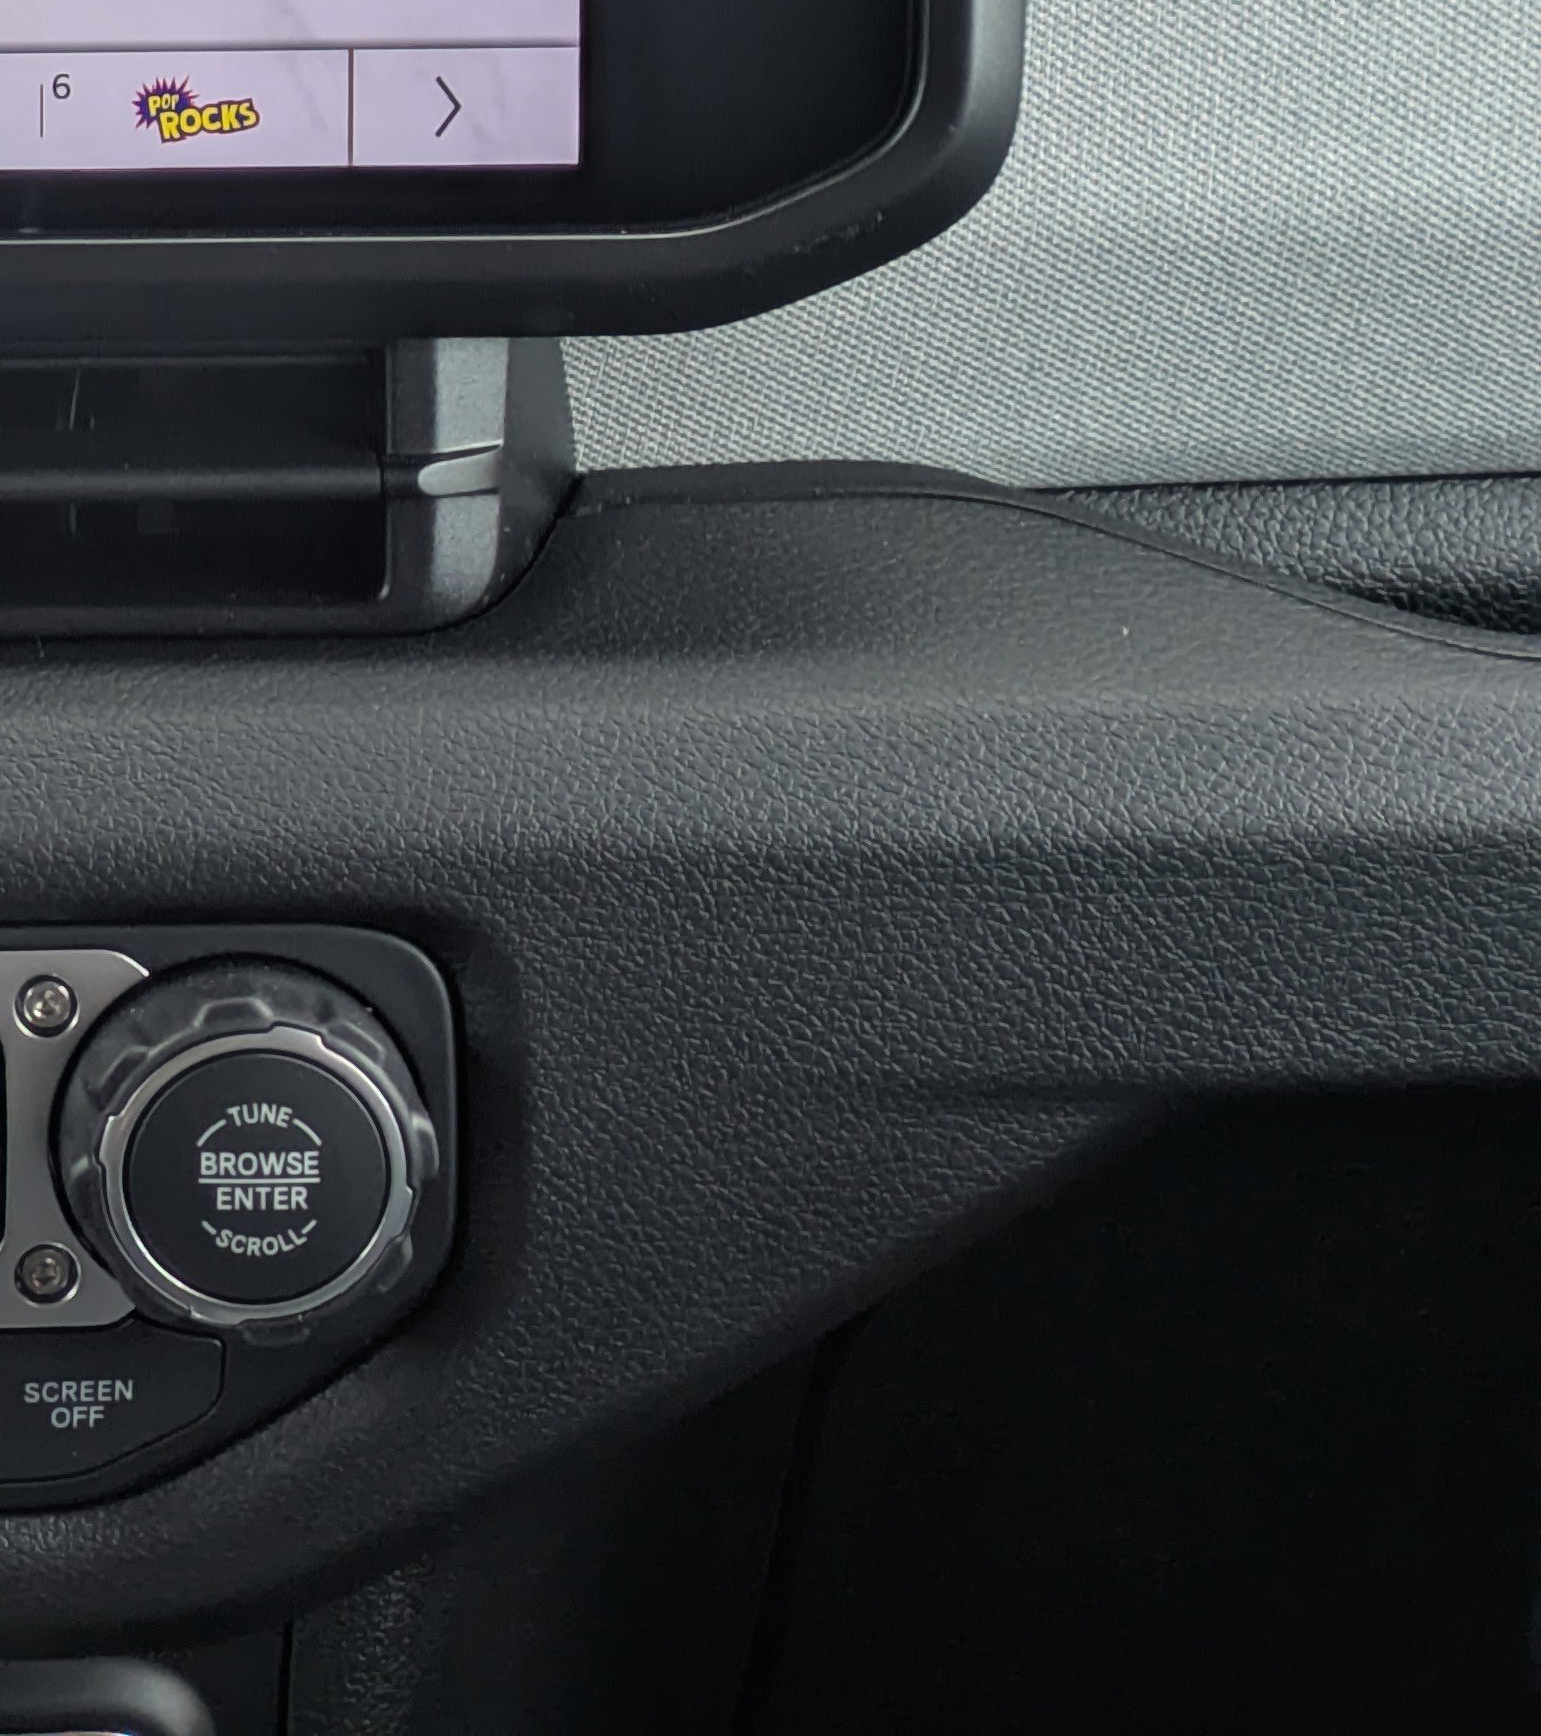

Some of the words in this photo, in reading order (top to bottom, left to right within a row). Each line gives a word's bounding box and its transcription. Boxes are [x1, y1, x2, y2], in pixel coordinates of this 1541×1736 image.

[52, 74, 71, 100] 6
[148, 93, 180, 117] POP
[159, 102, 258, 140] ROCKS
[227, 1105, 294, 1129] TUNE
[200, 1151, 320, 1176] BROWSE
[216, 1185, 308, 1211] ENTER
[215, 1226, 306, 1257] SCROLL
[24, 1379, 134, 1403] SCREEN
[50, 1406, 105, 1429] OFF
